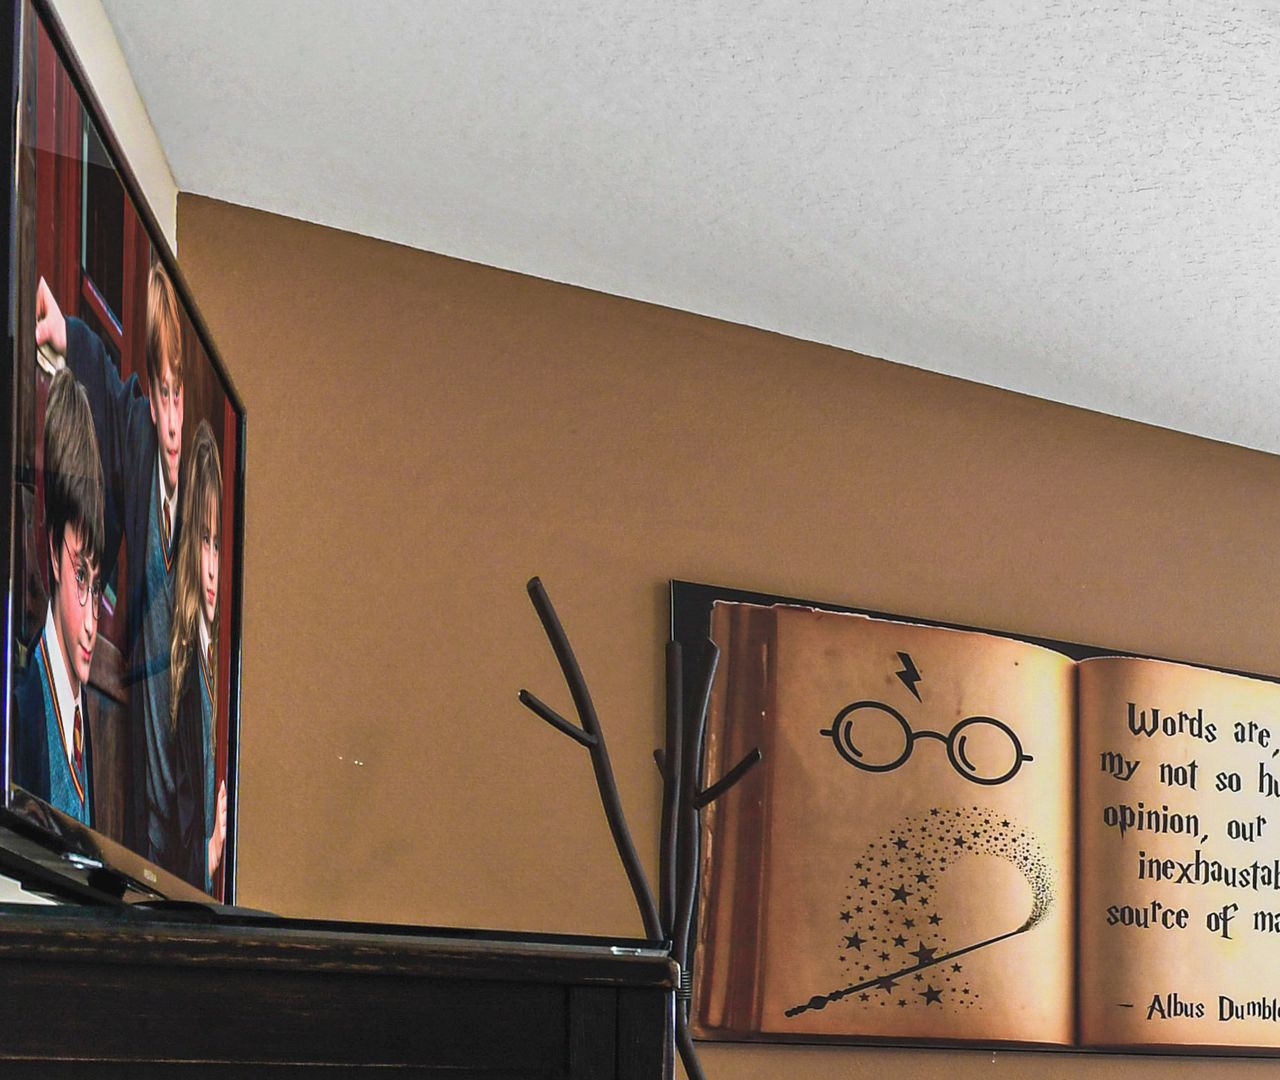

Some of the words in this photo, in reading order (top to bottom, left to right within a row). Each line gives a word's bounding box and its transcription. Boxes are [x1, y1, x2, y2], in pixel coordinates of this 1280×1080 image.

[1126, 702, 1218, 743] Words
[1233, 720, 1280, 759] are,
[1100, 749, 1141, 782] my
[1159, 759, 1199, 792] not
[1215, 771, 1242, 793] so
[1103, 801, 1209, 844] opinion,
[1226, 814, 1268, 844] our
[1105, 899, 1190, 930] source
[1206, 902, 1239, 940] of
[1145, 992, 1205, 1021] Albus
